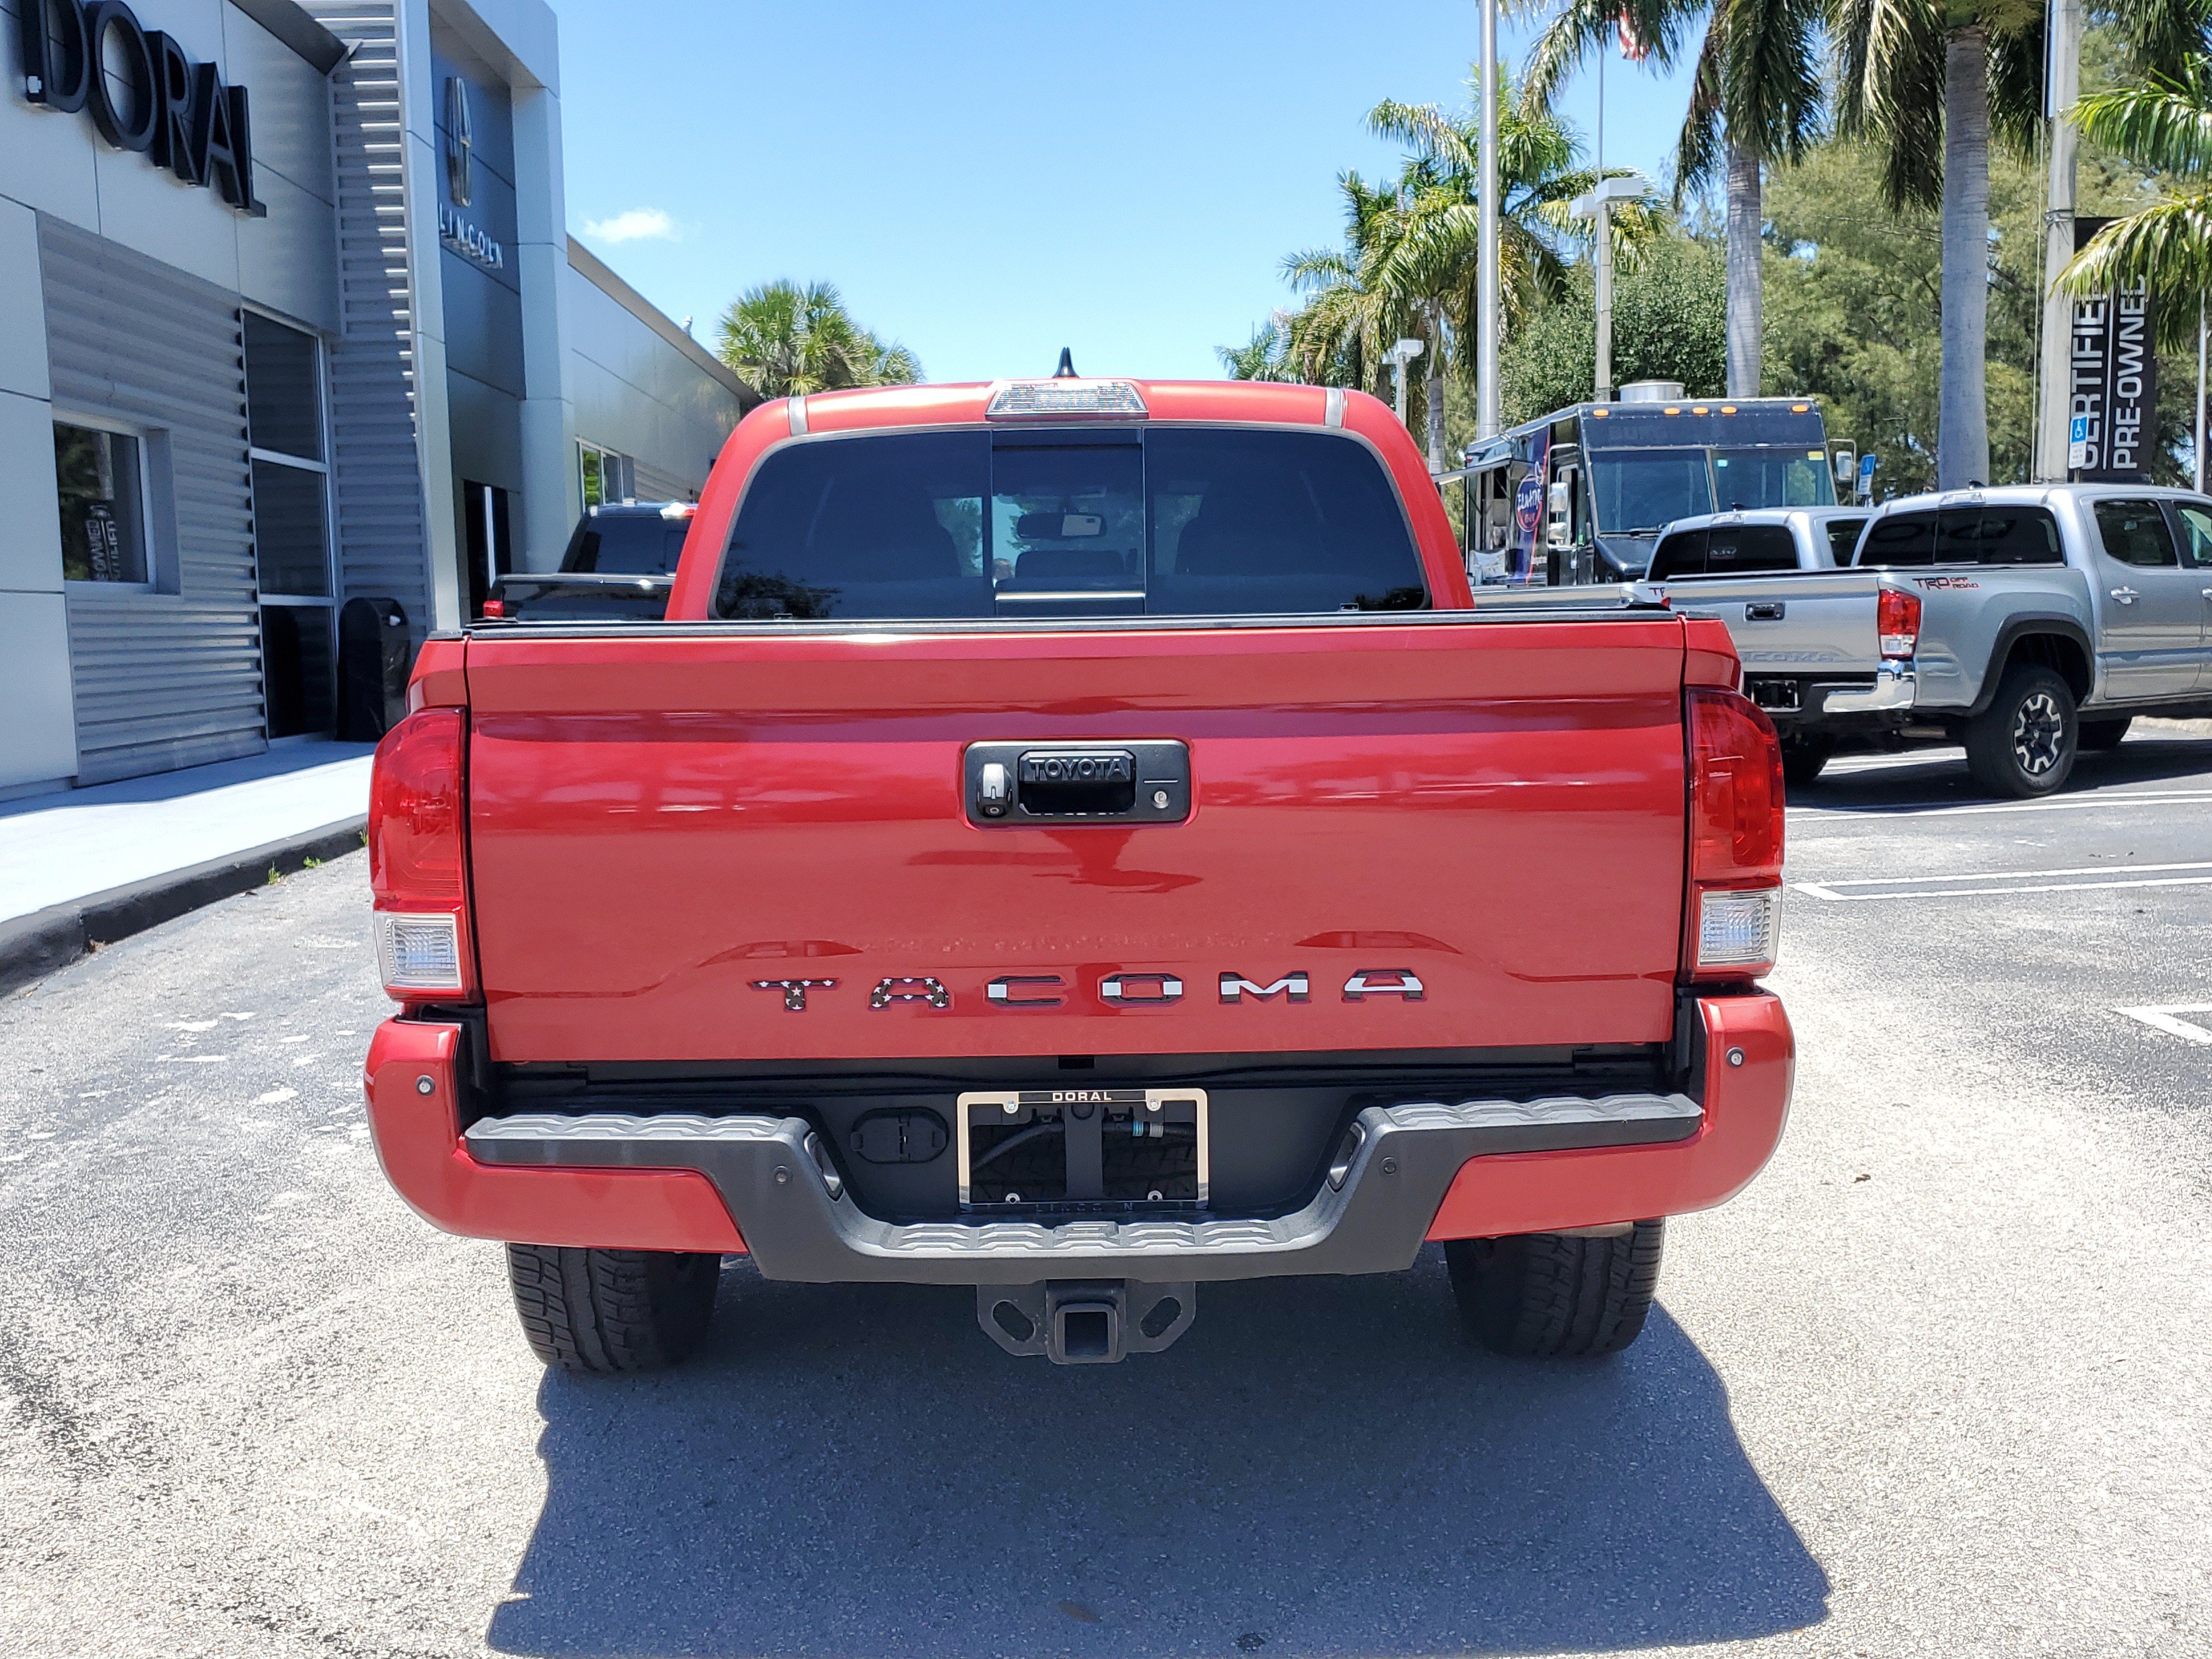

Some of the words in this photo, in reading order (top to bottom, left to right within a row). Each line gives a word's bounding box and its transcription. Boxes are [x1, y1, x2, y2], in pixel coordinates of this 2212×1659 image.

[22, 0, 267, 218] DORAL
[439, 201, 503, 269] LINCOLN
[2070, 279, 2106, 470] RTIFIE
[1911, 577, 1950, 591] TRD
[1029, 758, 1130, 781] TOYOTA
[749, 970, 1426, 1011] TACOMA
[1052, 1091, 1112, 1102] DORAL
[1035, 1202, 1133, 1212] LINCON
